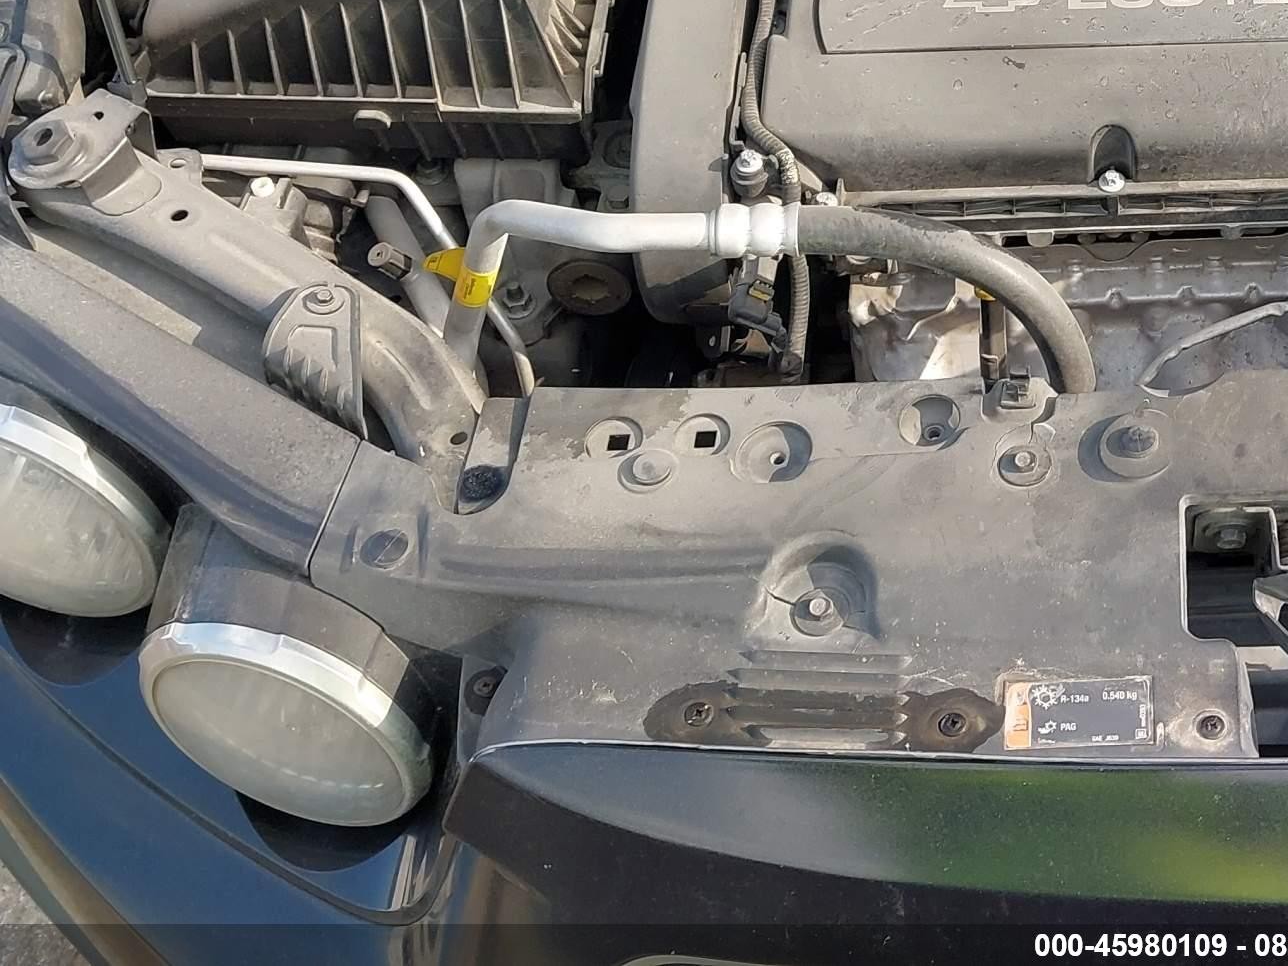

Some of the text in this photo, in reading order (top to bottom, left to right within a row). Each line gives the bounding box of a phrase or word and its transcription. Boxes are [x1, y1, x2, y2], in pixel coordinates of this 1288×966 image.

[1060, 694, 1089, 703] R-134a
[1102, 690, 1125, 700] 0.540
[1060, 722, 1077, 731] PAG
